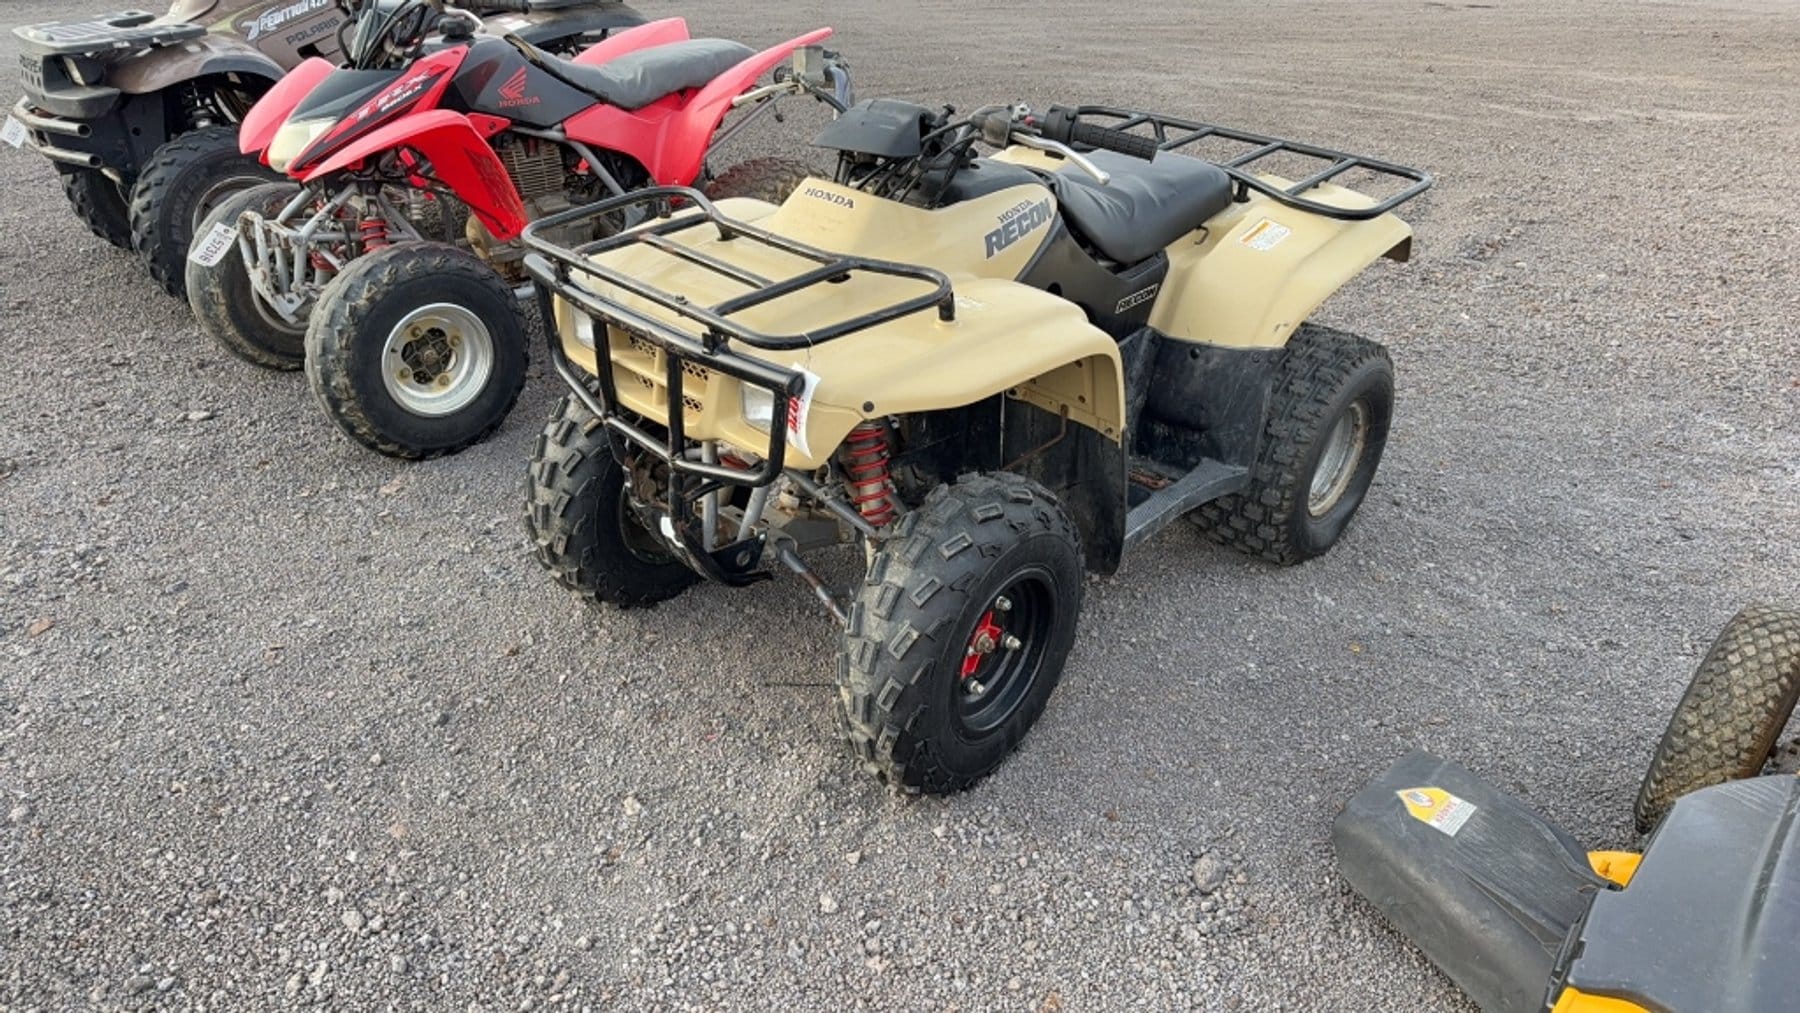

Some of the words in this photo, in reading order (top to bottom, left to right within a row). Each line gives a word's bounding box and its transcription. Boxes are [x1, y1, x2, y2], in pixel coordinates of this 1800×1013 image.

[285, 16, 340, 45] POLARIS
[497, 95, 542, 108] HONDA
[804, 188, 855, 209] HONDA
[997, 199, 1034, 224] HONDA
[984, 197, 1053, 260] RECON
[1114, 282, 1159, 314] RECON
